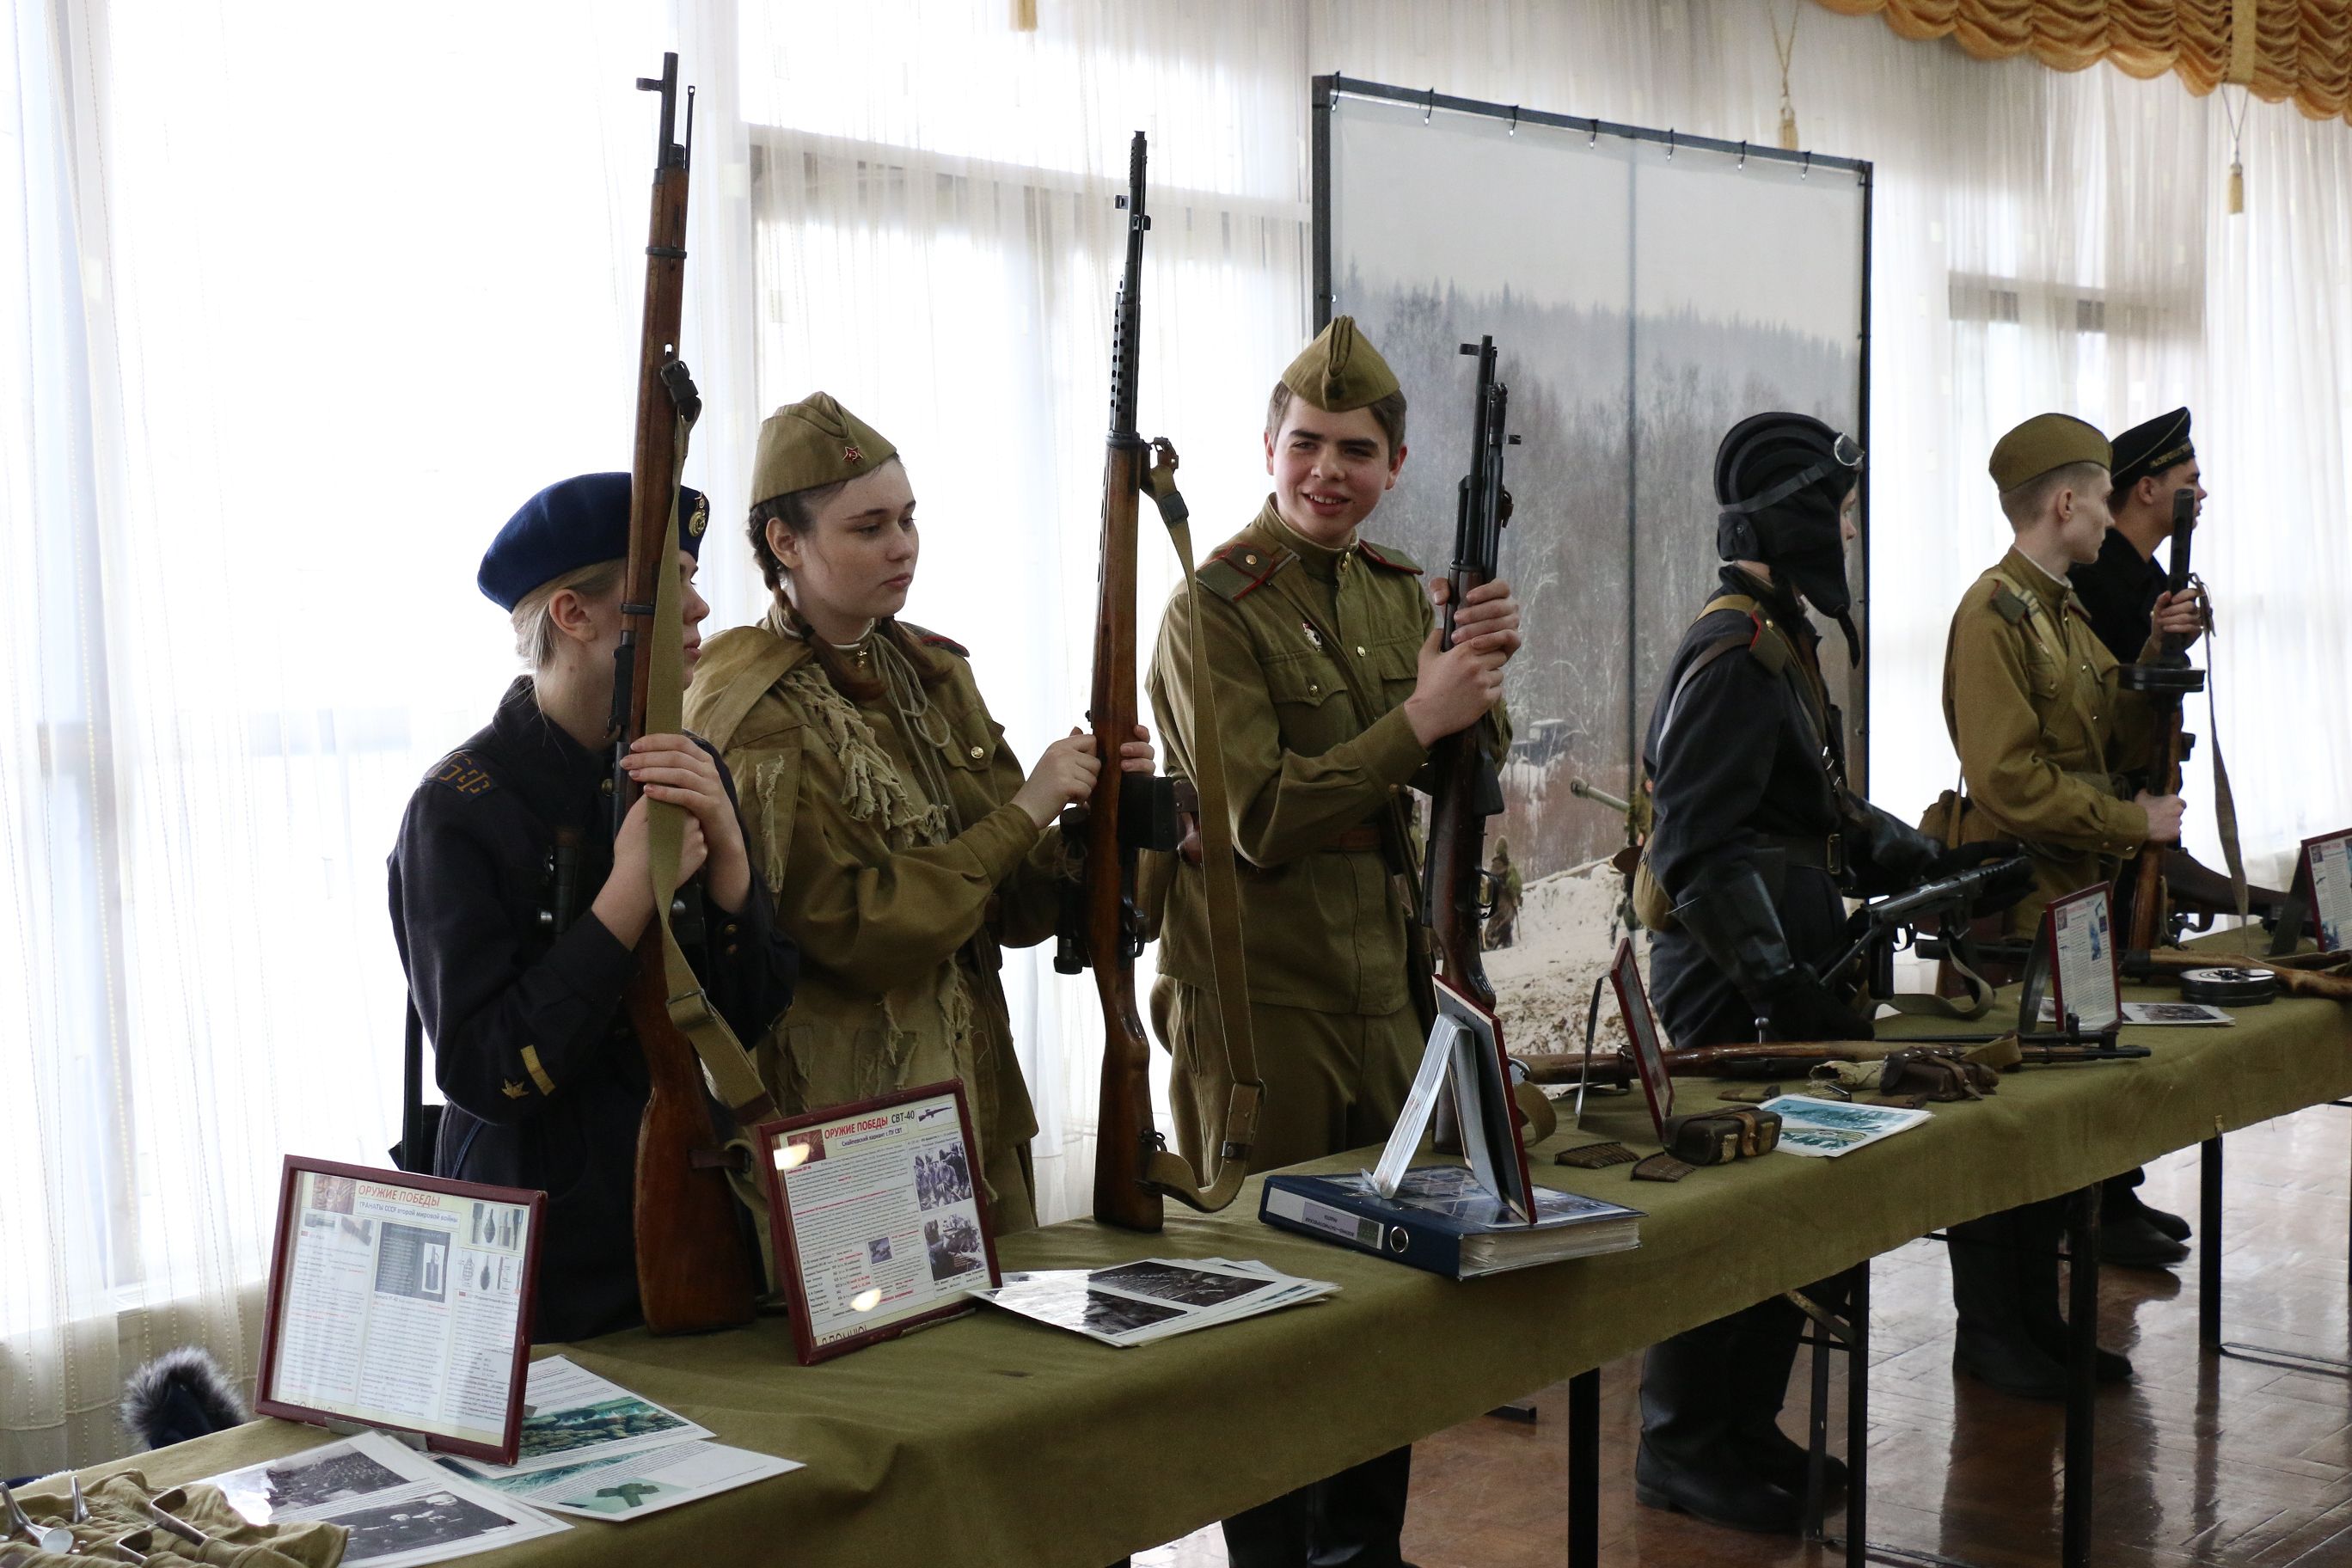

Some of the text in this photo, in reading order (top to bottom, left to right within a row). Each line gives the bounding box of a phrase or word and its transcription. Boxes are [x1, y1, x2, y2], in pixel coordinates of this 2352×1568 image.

[824, 1110, 915, 1139] ОРУЖИЕ ПОБЕДЫ СВТ-40
[358, 1185, 440, 1207] ОРУЖИЕ ПОБЕДЫ
[416, 1211, 439, 1220] мировой
